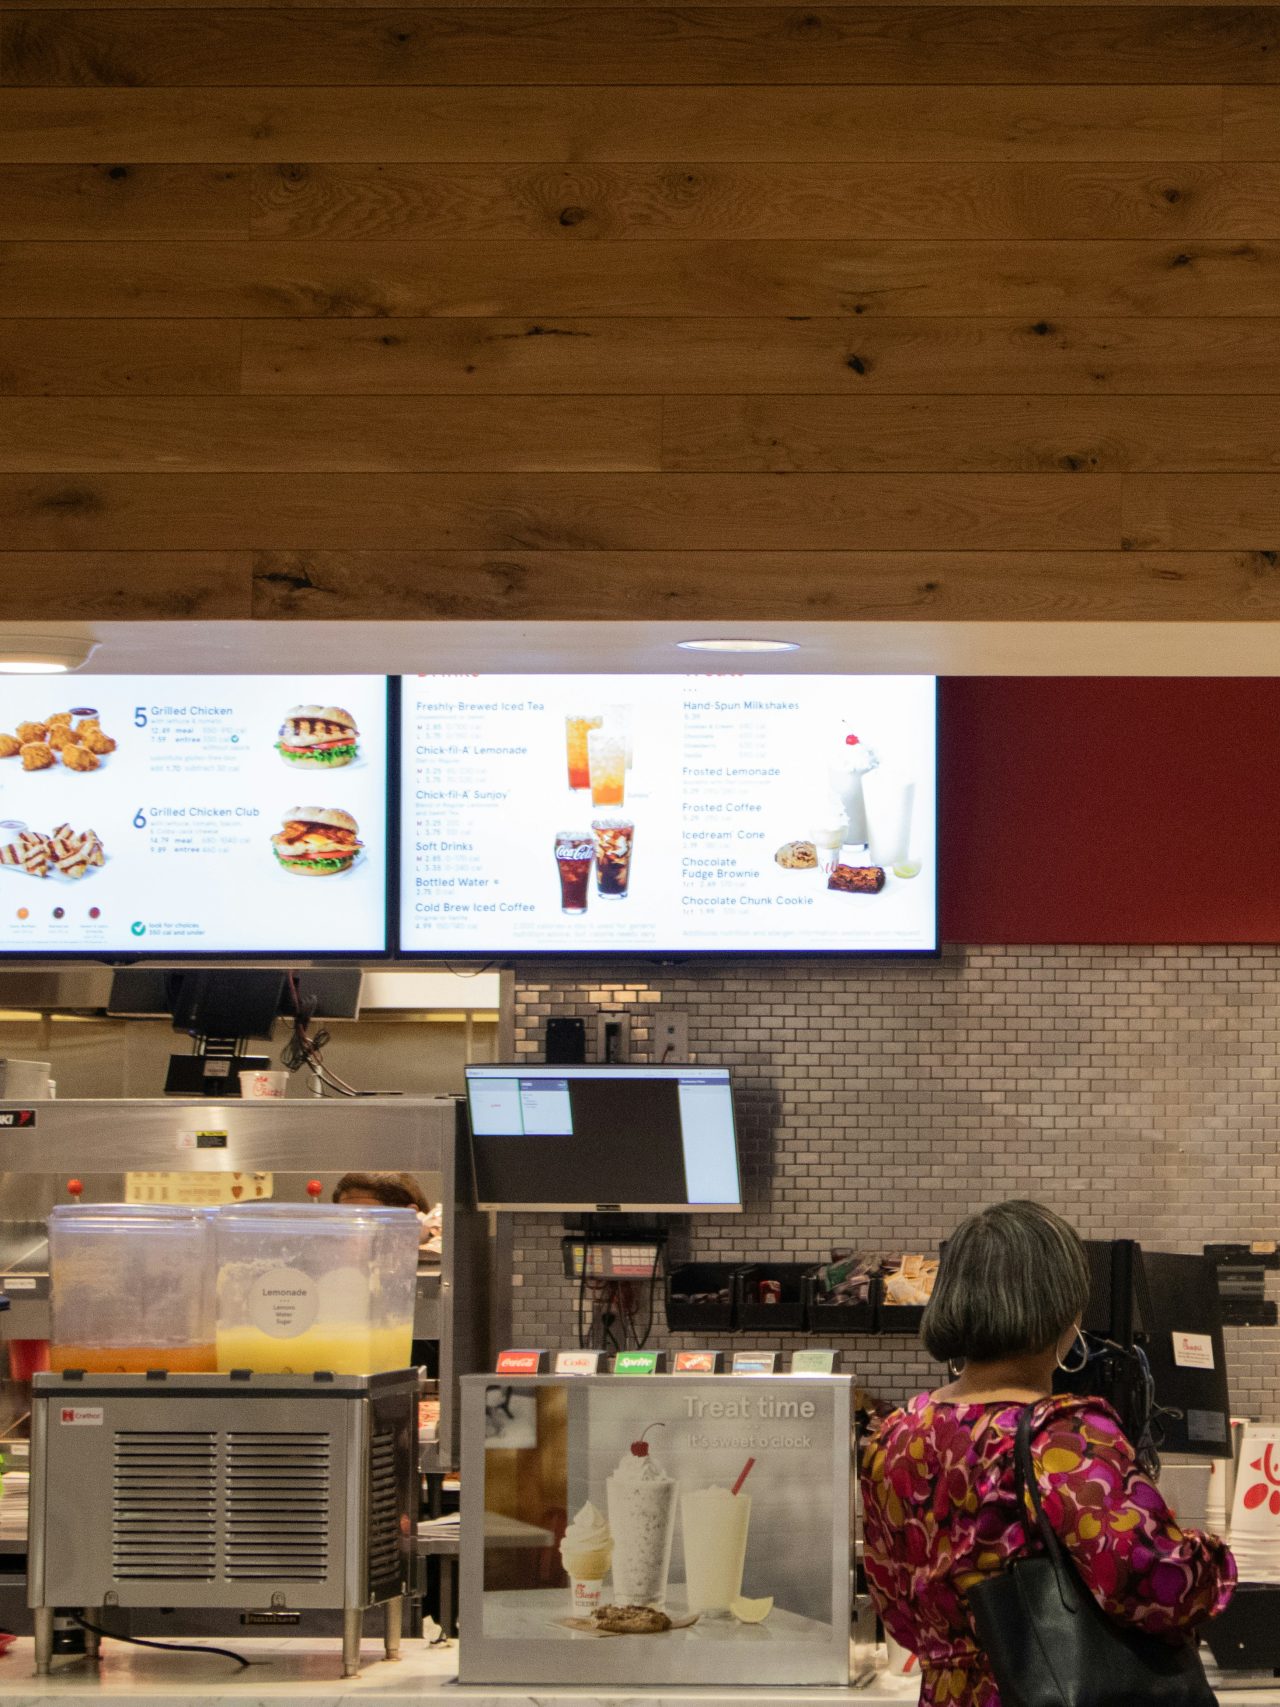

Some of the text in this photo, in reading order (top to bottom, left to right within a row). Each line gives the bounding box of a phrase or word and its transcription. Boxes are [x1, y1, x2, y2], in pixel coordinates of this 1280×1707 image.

[150, 706, 233, 716] Grilled Chicken
[416, 701, 544, 712] Freshly-Brewed Iced Tea
[683, 701, 799, 711] Hand-Spun Milkshakes
[134, 707, 148, 728] 5
[474, 747, 528, 755] Lemonade
[682, 767, 781, 776] Frosted Lemonade
[149, 807, 260, 817] Grilled Chicken Club
[682, 802, 762, 812] Frosted Coffee
[132, 808, 147, 829] 6
[737, 830, 765, 839] Cone
[416, 841, 473, 851] Soft Drinks
[681, 857, 737, 867] Chocolate
[682, 868, 760, 880] Fudge Brownie
[415, 877, 489, 887] Bottled Water
[681, 896, 814, 905] Chocolate Chunk Cookie
[415, 902, 535, 912] Cold Brew Iced Coffee
[619, 1357, 653, 1369] Sprite
[683, 1395, 816, 1418] Treat time
